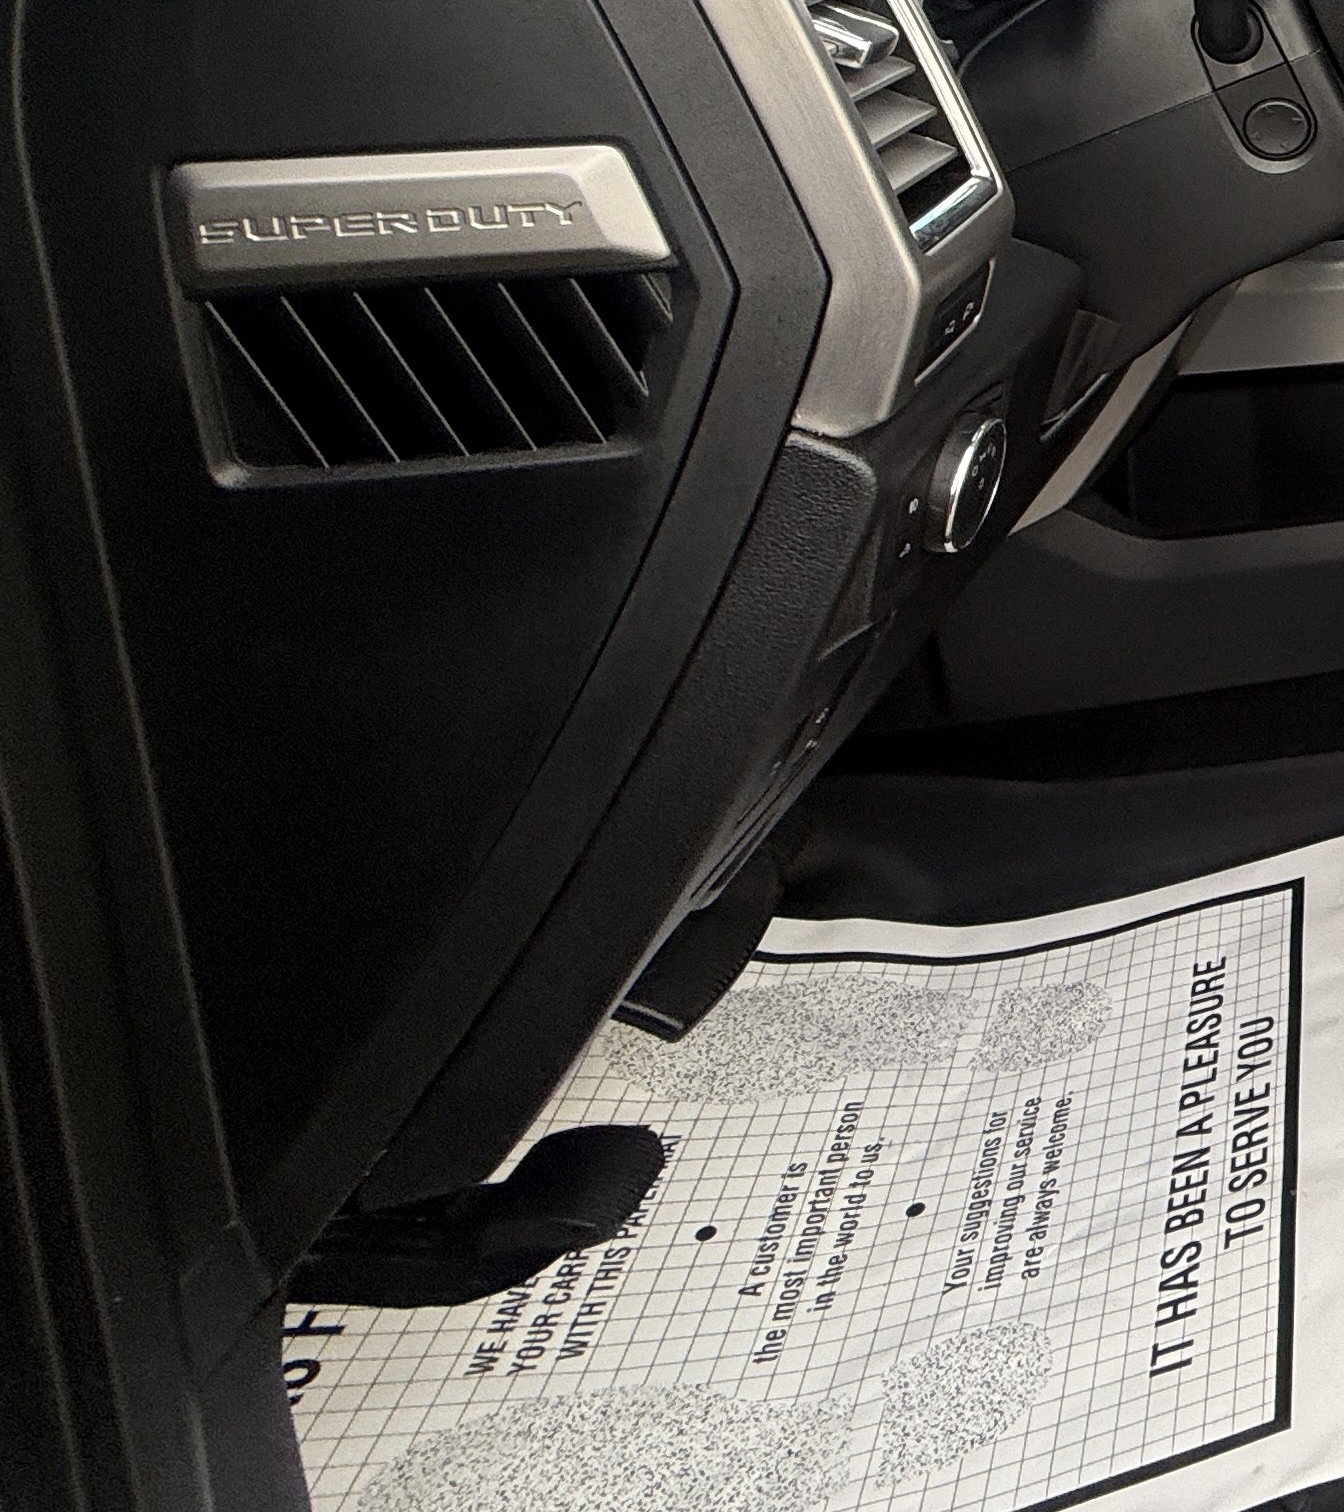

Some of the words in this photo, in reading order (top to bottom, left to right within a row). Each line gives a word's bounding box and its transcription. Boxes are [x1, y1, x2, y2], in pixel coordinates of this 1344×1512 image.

[1179, 955, 1228, 1109] PLEASURE
[1236, 1015, 1275, 1083] YOU
[830, 1101, 865, 1163] person
[1014, 1096, 1042, 1159] service
[1042, 1091, 1074, 1175] welcome.
[1175, 1112, 1213, 1137] A
[1228, 1081, 1272, 1193] SERVE
[848, 1169, 875, 1190] to
[942, 1248, 975, 1296] Your
[960, 1136, 1002, 1244] suggestions
[984, 1110, 1010, 1135] for
[1006, 1162, 1028, 1192] our
[1165, 1146, 1212, 1236] BEEN
[738, 1286, 762, 1297] A
[750, 1183, 798, 1277] customer
[782, 1161, 808, 1180] is
[787, 1169, 838, 1264] important
[834, 1192, 867, 1252] world
[1026, 1178, 1060, 1242] always
[1224, 1197, 1267, 1251] TO
[817, 1252, 848, 1288] the
[978, 1193, 1026, 1292] improving
[1021, 1244, 1044, 1280] are
[506, 1311, 563, 1377] YOUR
[543, 1250, 589, 1305] CARP
[556, 1299, 608, 1362] WITH
[586, 1246, 631, 1304] THIS
[772, 1270, 808, 1321] most
[807, 1290, 836, 1313] in
[1154, 1240, 1202, 1328] HAS
[463, 1339, 509, 1376] WE
[487, 1277, 540, 1335] HAVE
[752, 1328, 787, 1365] the
[1149, 1338, 1194, 1378] IT
